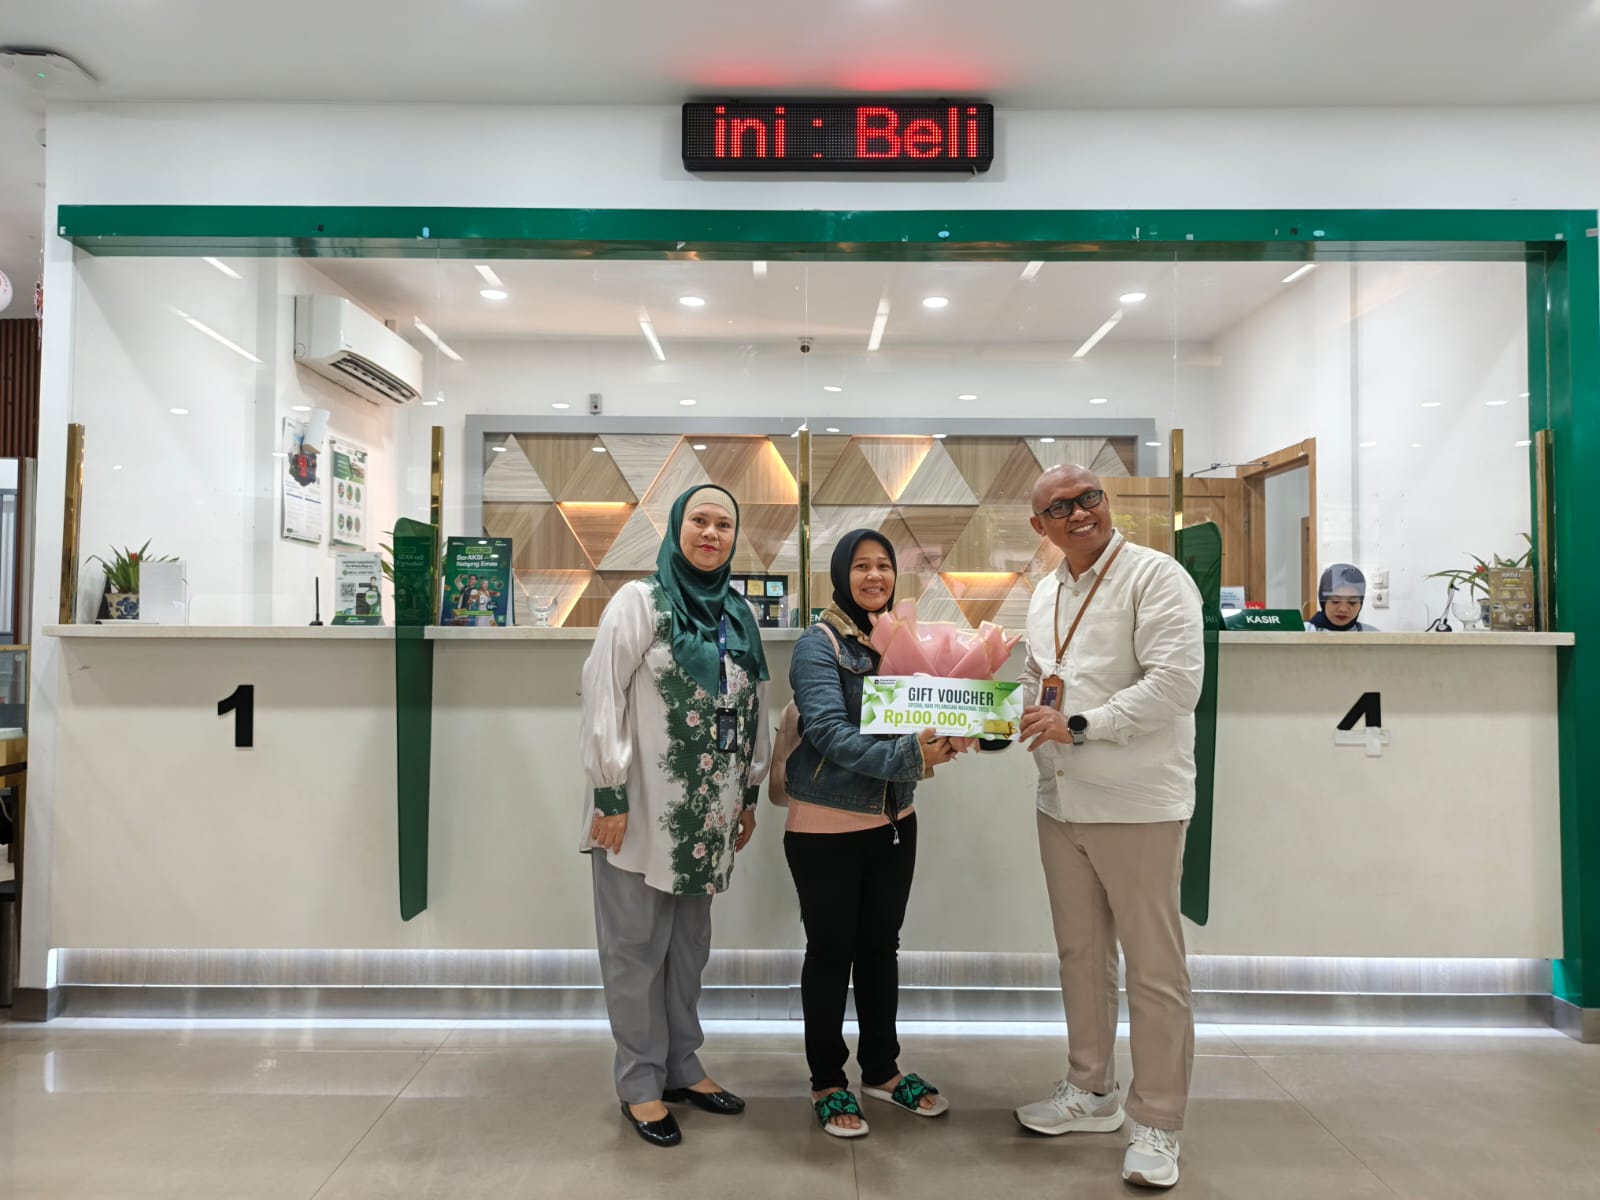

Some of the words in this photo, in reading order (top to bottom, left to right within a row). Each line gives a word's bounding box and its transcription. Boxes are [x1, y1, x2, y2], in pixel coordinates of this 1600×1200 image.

[714, 106, 785, 158] ini
[856, 106, 977, 158] Beli
[1246, 615, 1281, 624] KASIR
[908, 687, 934, 702] GIFT
[938, 688, 994, 706] VOUCHER
[217, 685, 254, 747] 1
[883, 709, 979, 730] Rp100.000,-
